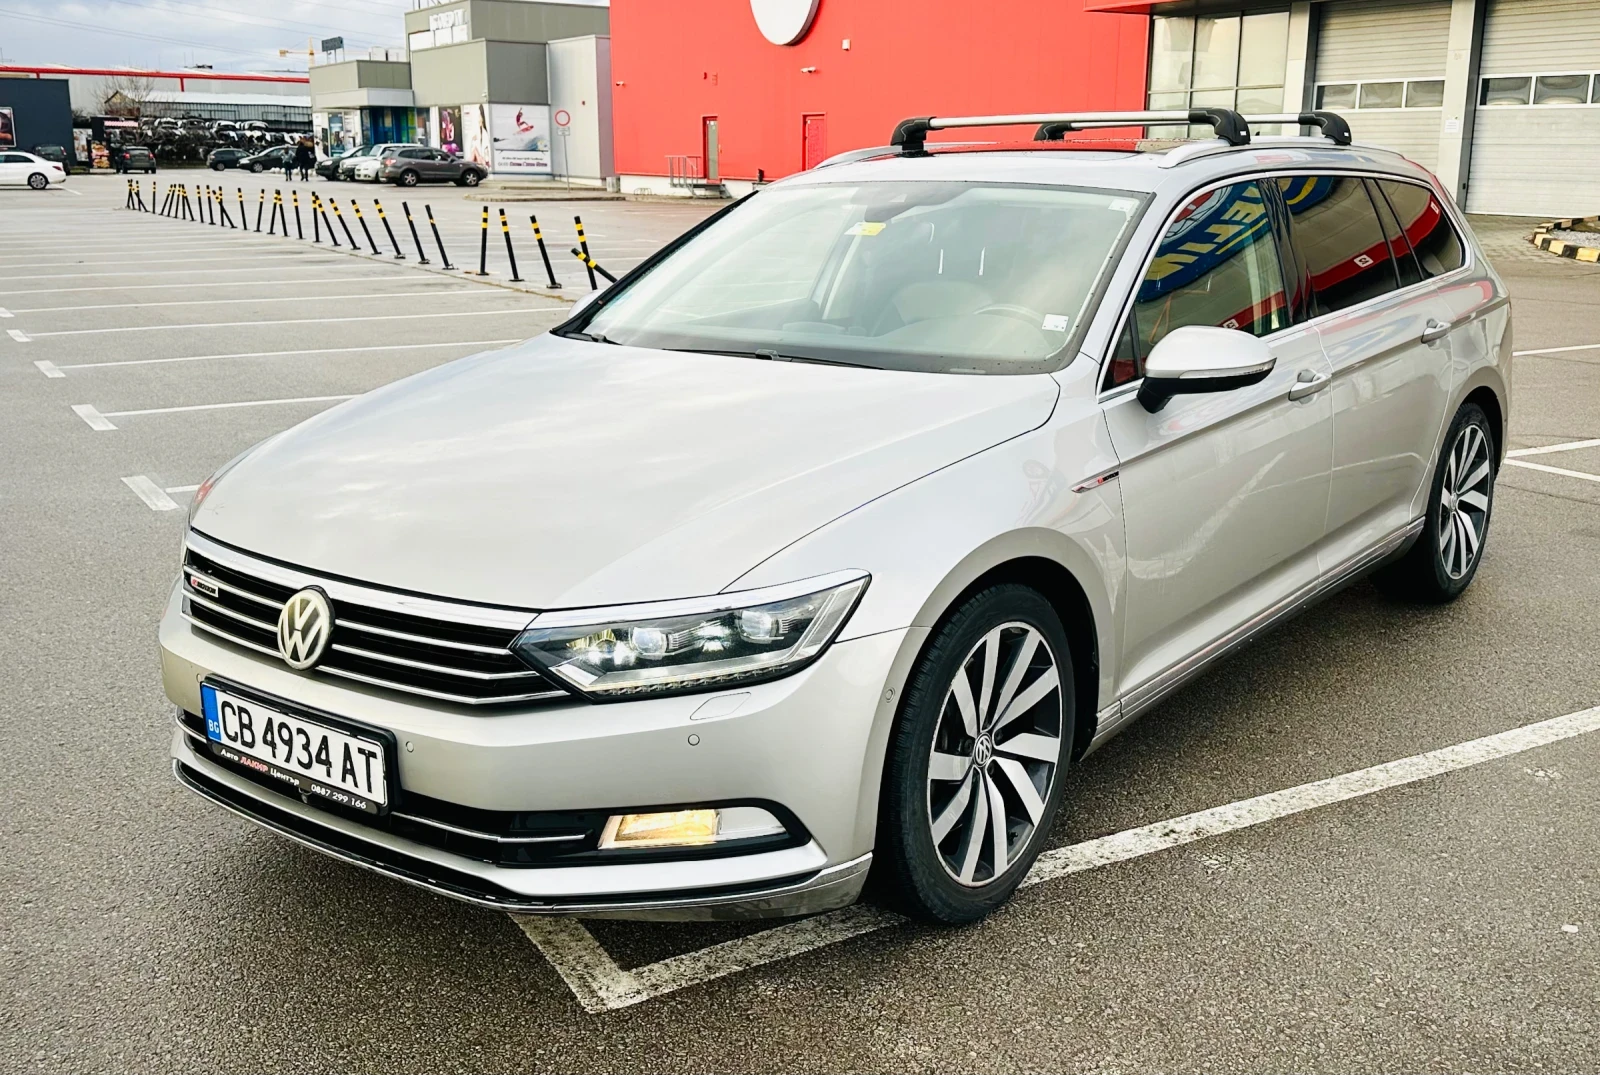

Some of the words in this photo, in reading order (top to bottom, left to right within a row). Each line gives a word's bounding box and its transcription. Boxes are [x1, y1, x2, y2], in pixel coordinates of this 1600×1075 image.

[208, 719, 220, 734] BG
[221, 700, 256, 749] CB
[262, 717, 332, 778] 4934
[341, 742, 377, 794] AT
[220, 748, 239, 761] Авто
[270, 767, 300, 786] Център
[311, 784, 331, 797] 0887
[332, 792, 349, 803] 299
[351, 797, 367, 809] 166
